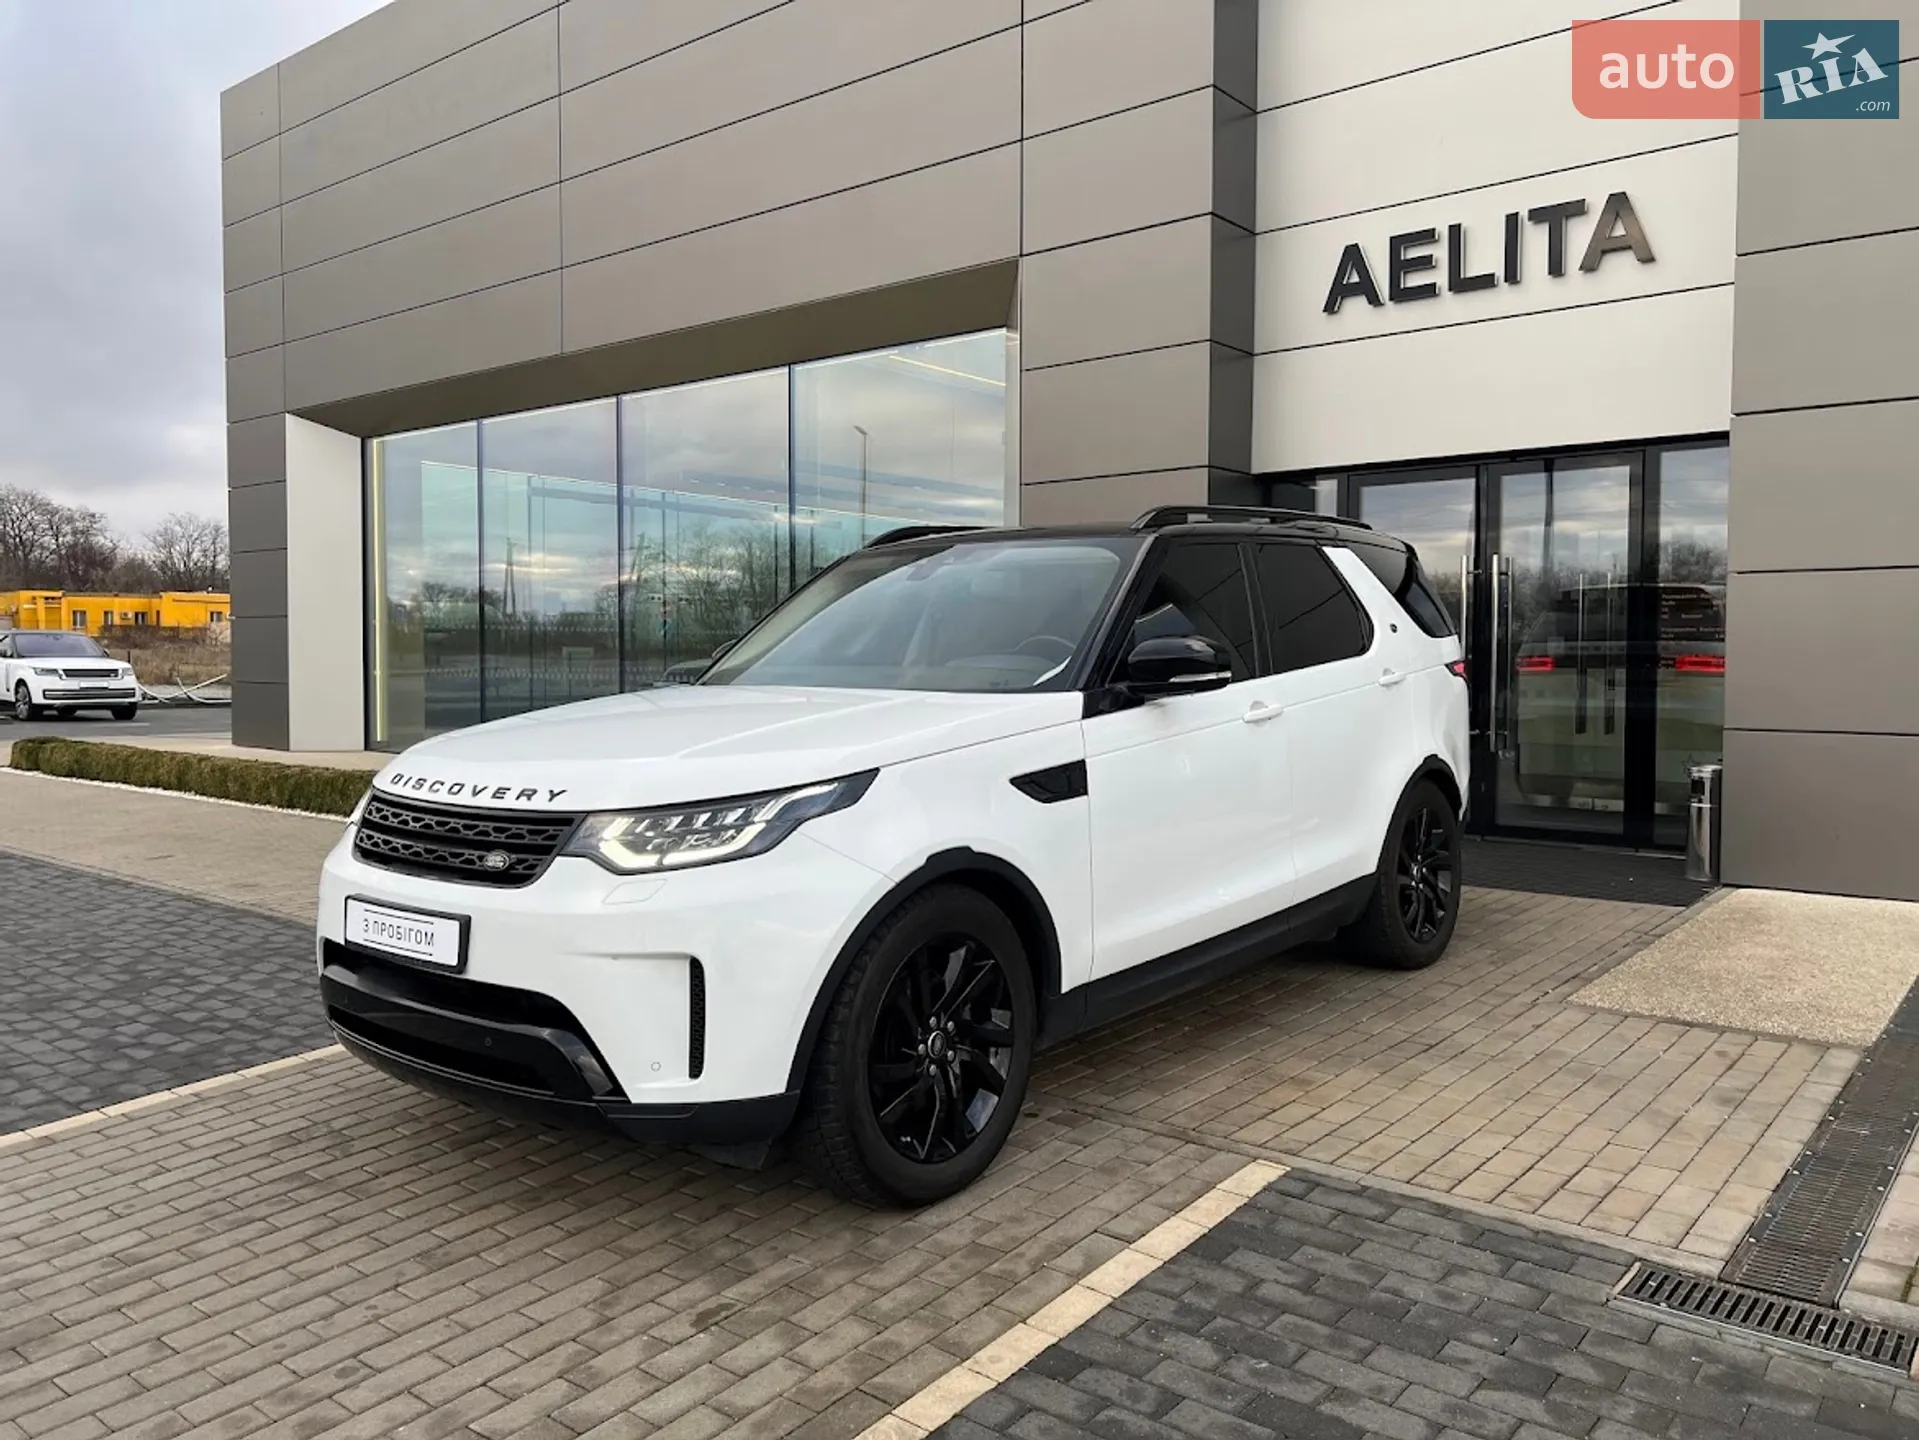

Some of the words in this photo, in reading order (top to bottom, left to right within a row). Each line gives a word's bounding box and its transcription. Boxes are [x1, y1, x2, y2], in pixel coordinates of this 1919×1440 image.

[1322, 191, 1656, 315] AELITA
[390, 773, 568, 803] DISCOVERY
[363, 917, 370, 933] З
[372, 920, 434, 947] ПРОБІГОМ
